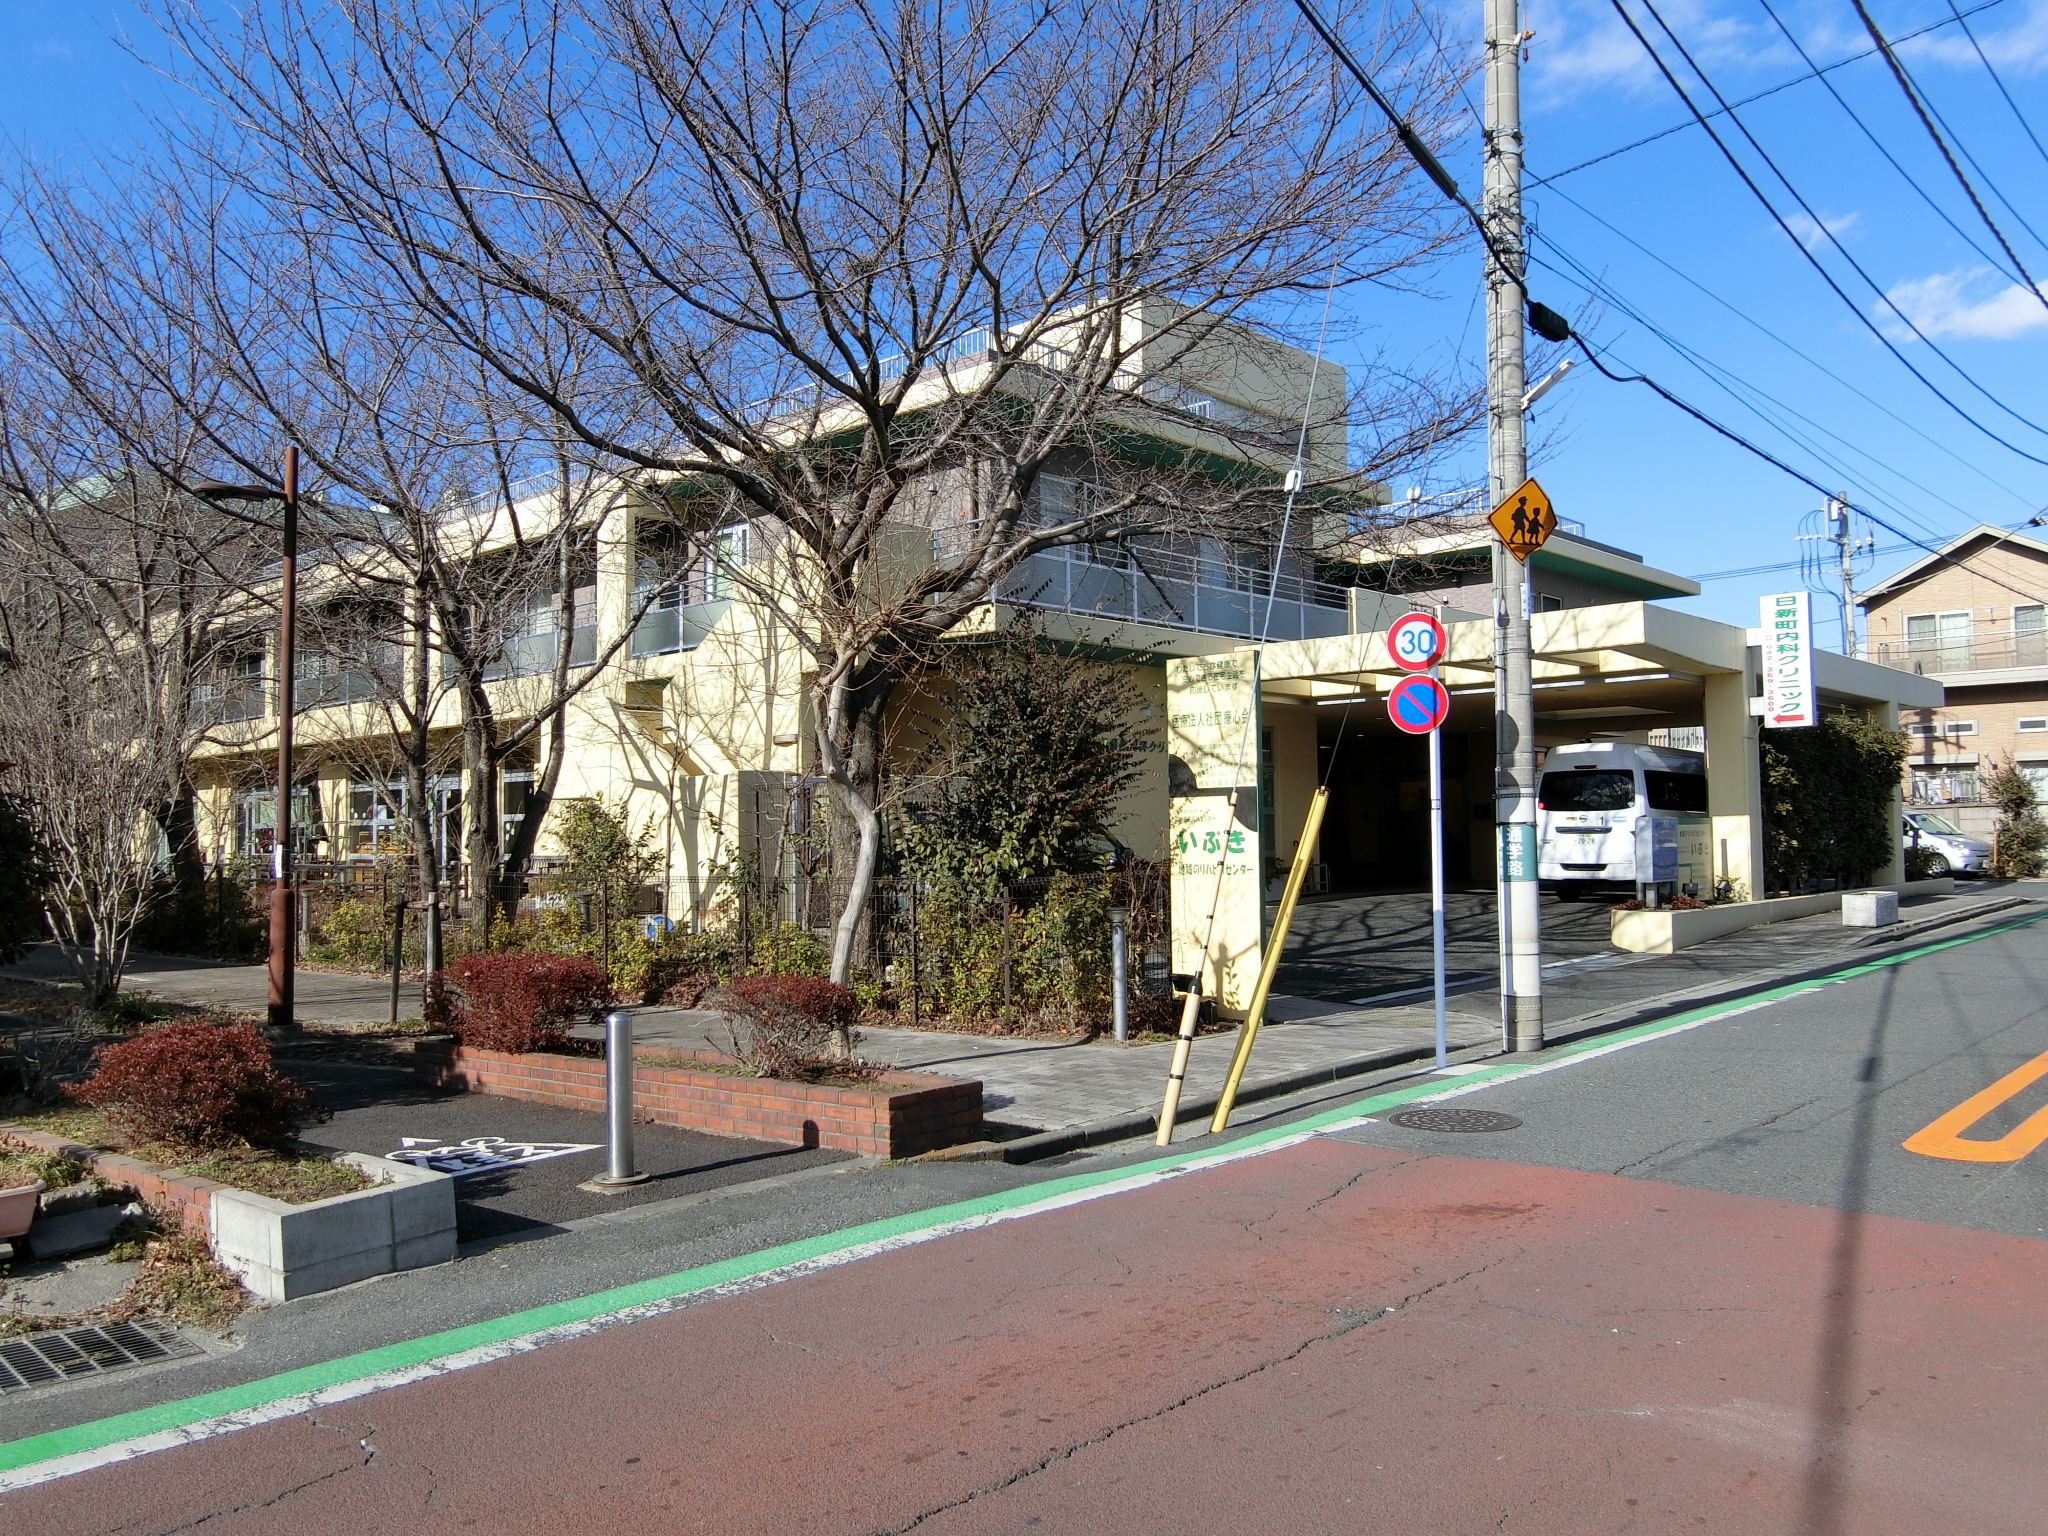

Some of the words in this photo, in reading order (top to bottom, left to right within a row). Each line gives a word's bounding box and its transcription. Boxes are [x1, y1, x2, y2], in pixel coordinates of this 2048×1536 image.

[1401, 629, 1434, 655] 30
[1775, 595, 1802, 713] 日新町内科クリニック
[1178, 830, 1246, 854] いぶき
[1506, 826, 1524, 877] 通学路
